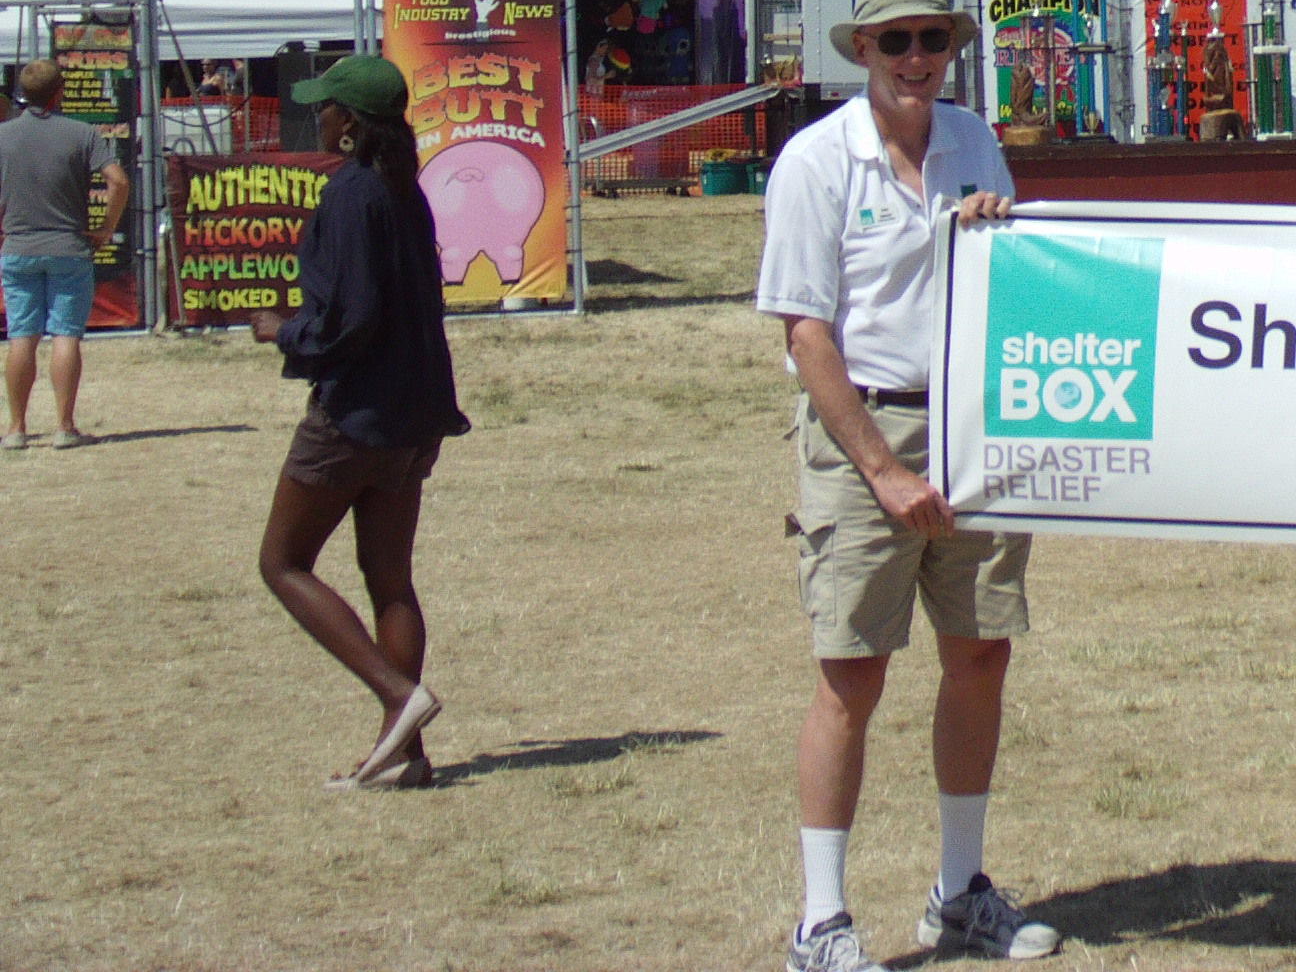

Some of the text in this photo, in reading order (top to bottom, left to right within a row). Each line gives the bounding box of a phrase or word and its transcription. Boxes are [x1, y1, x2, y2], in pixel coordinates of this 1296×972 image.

[412, 52, 541, 100] BEST
[411, 88, 544, 135] BUTT
[416, 124, 545, 152] IN AMERICA
[185, 215, 303, 247] HICKORY
[181, 252, 300, 282] APPLEWO
[184, 287, 278, 311] SMOKED
[1002, 332, 1141, 366] shelter
[1000, 367, 1138, 422] BOX
[984, 444, 1151, 474] DISASTER
[984, 475, 1101, 502] RELIEF
